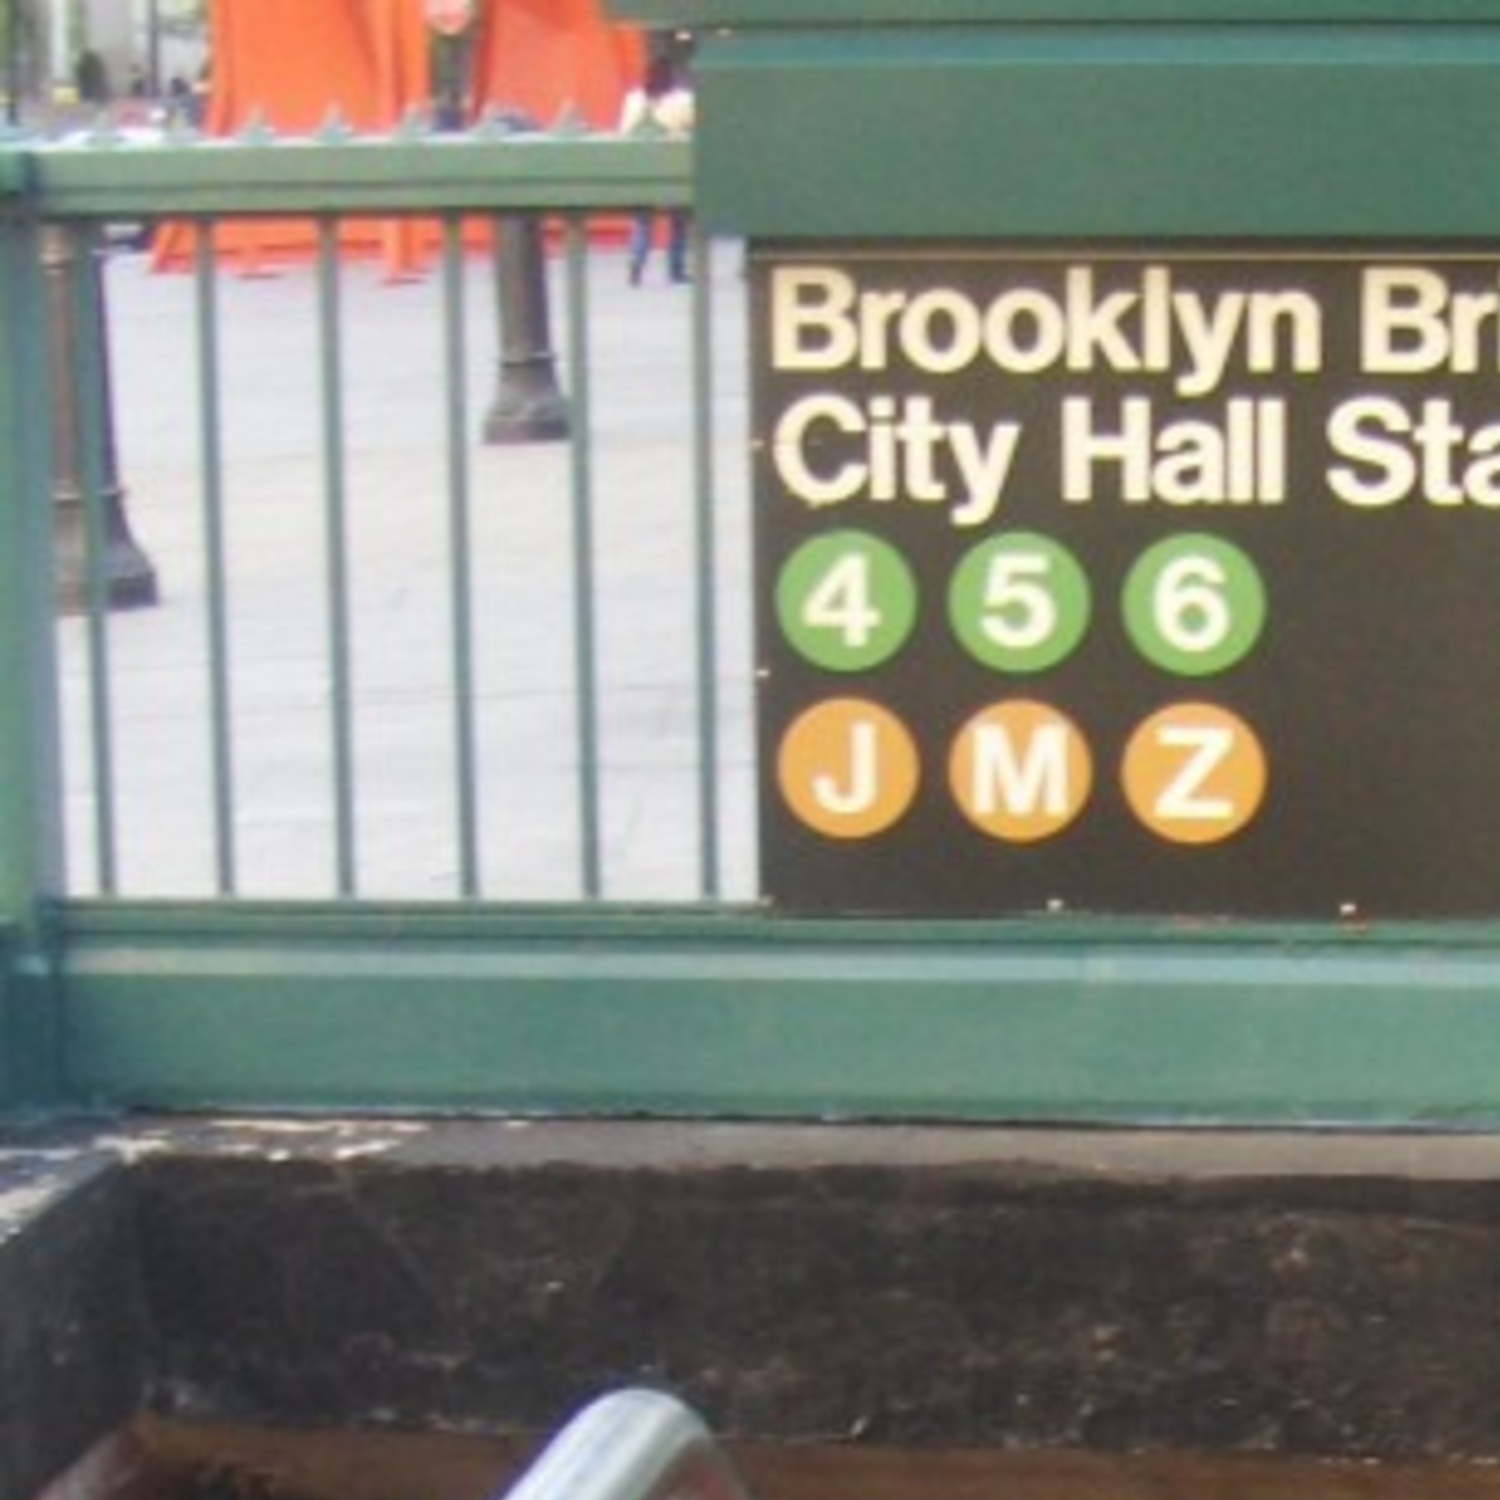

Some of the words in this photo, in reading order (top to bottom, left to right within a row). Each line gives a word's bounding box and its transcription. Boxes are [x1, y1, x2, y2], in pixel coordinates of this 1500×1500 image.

[771, 268, 1321, 396] Brooklyn
[772, 391, 1021, 526] City
[1061, 395, 1286, 504] Hall
[802, 550, 881, 648] 4
[978, 549, 1057, 648] 5
[1152, 551, 1231, 652] 6
[812, 720, 877, 814] J
[970, 719, 1069, 815] M
[1154, 722, 1233, 819] Z
